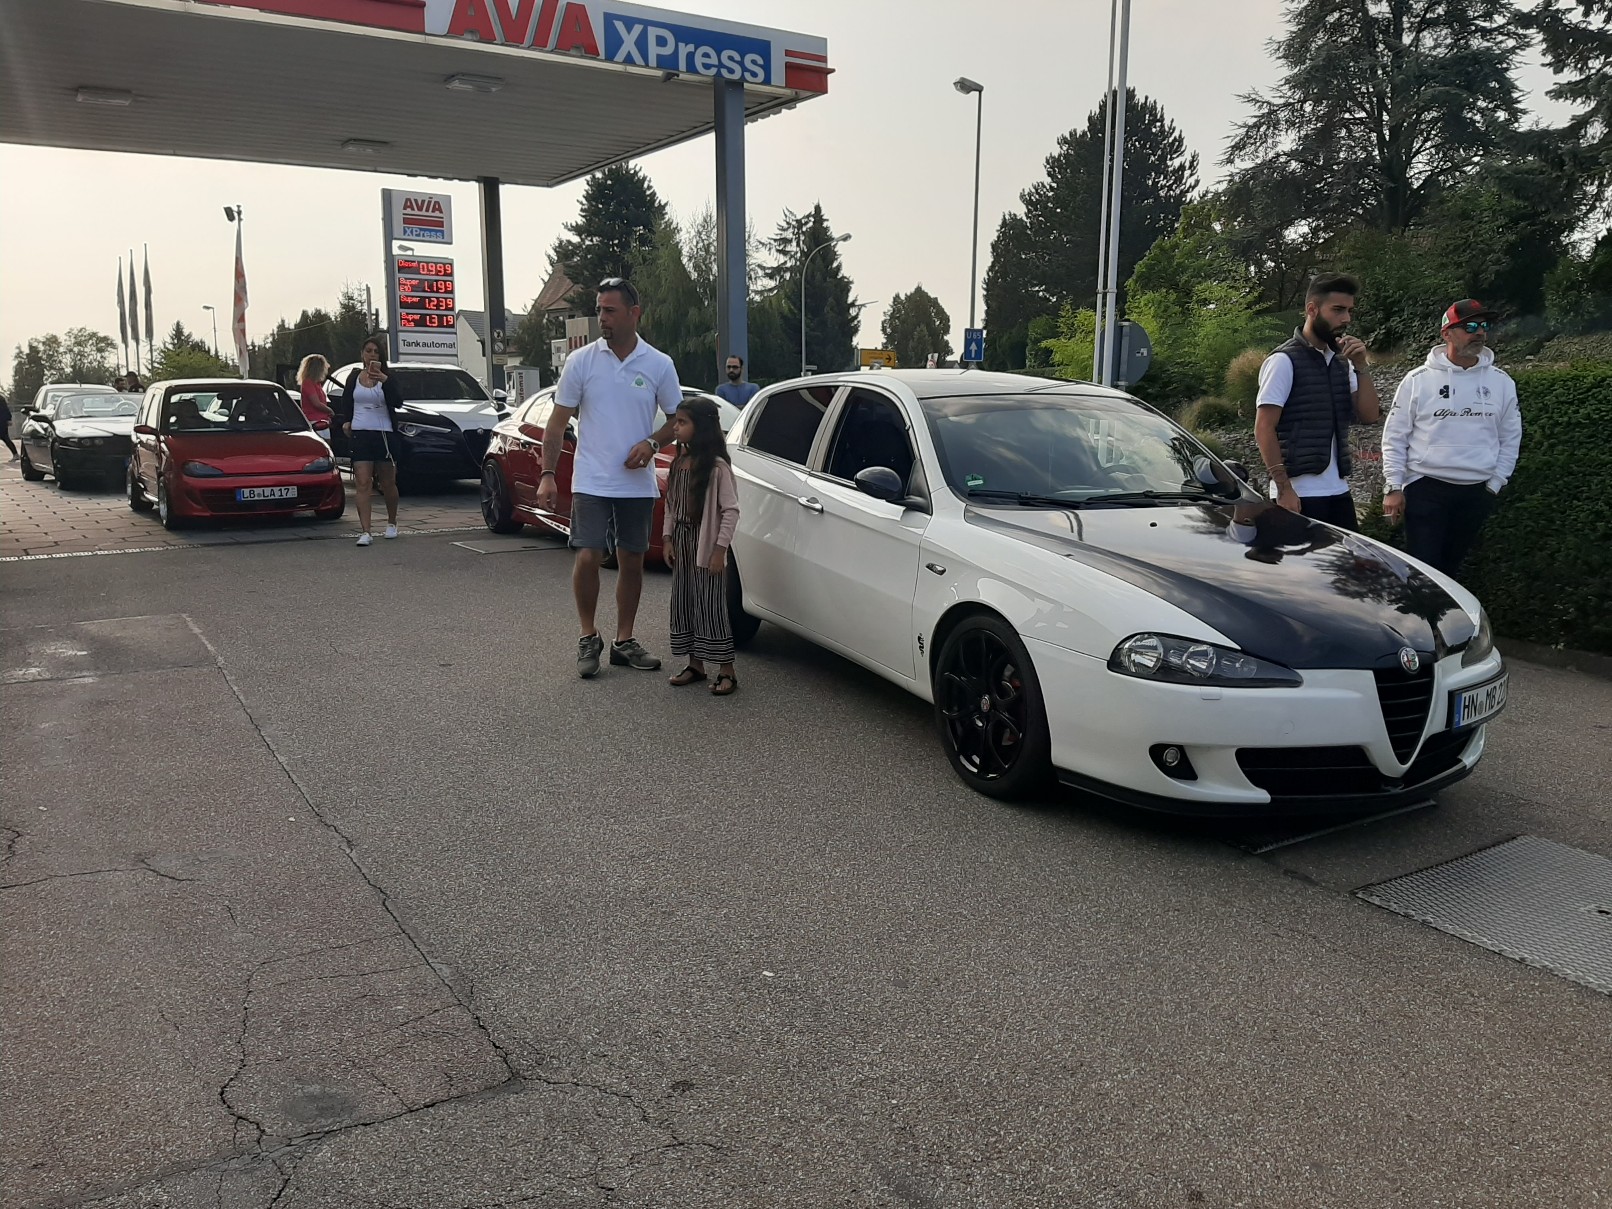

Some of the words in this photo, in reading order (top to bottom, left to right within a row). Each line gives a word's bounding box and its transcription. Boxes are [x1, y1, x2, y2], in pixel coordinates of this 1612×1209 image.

[613, 20, 765, 84] XPress
[404, 227, 443, 240] XPress
[398, 260, 418, 268] Diesel
[400, 278, 420, 287] Super
[401, 295, 421, 304] Super
[401, 312, 421, 321] Super
[401, 339, 456, 349] Tankautomat
[1433, 408, 1457, 421] Alfa
[242, 489, 256, 499] LB
[262, 488, 276, 498] LA
[278, 487, 290, 498] 17
[1462, 693, 1478, 721] HN
